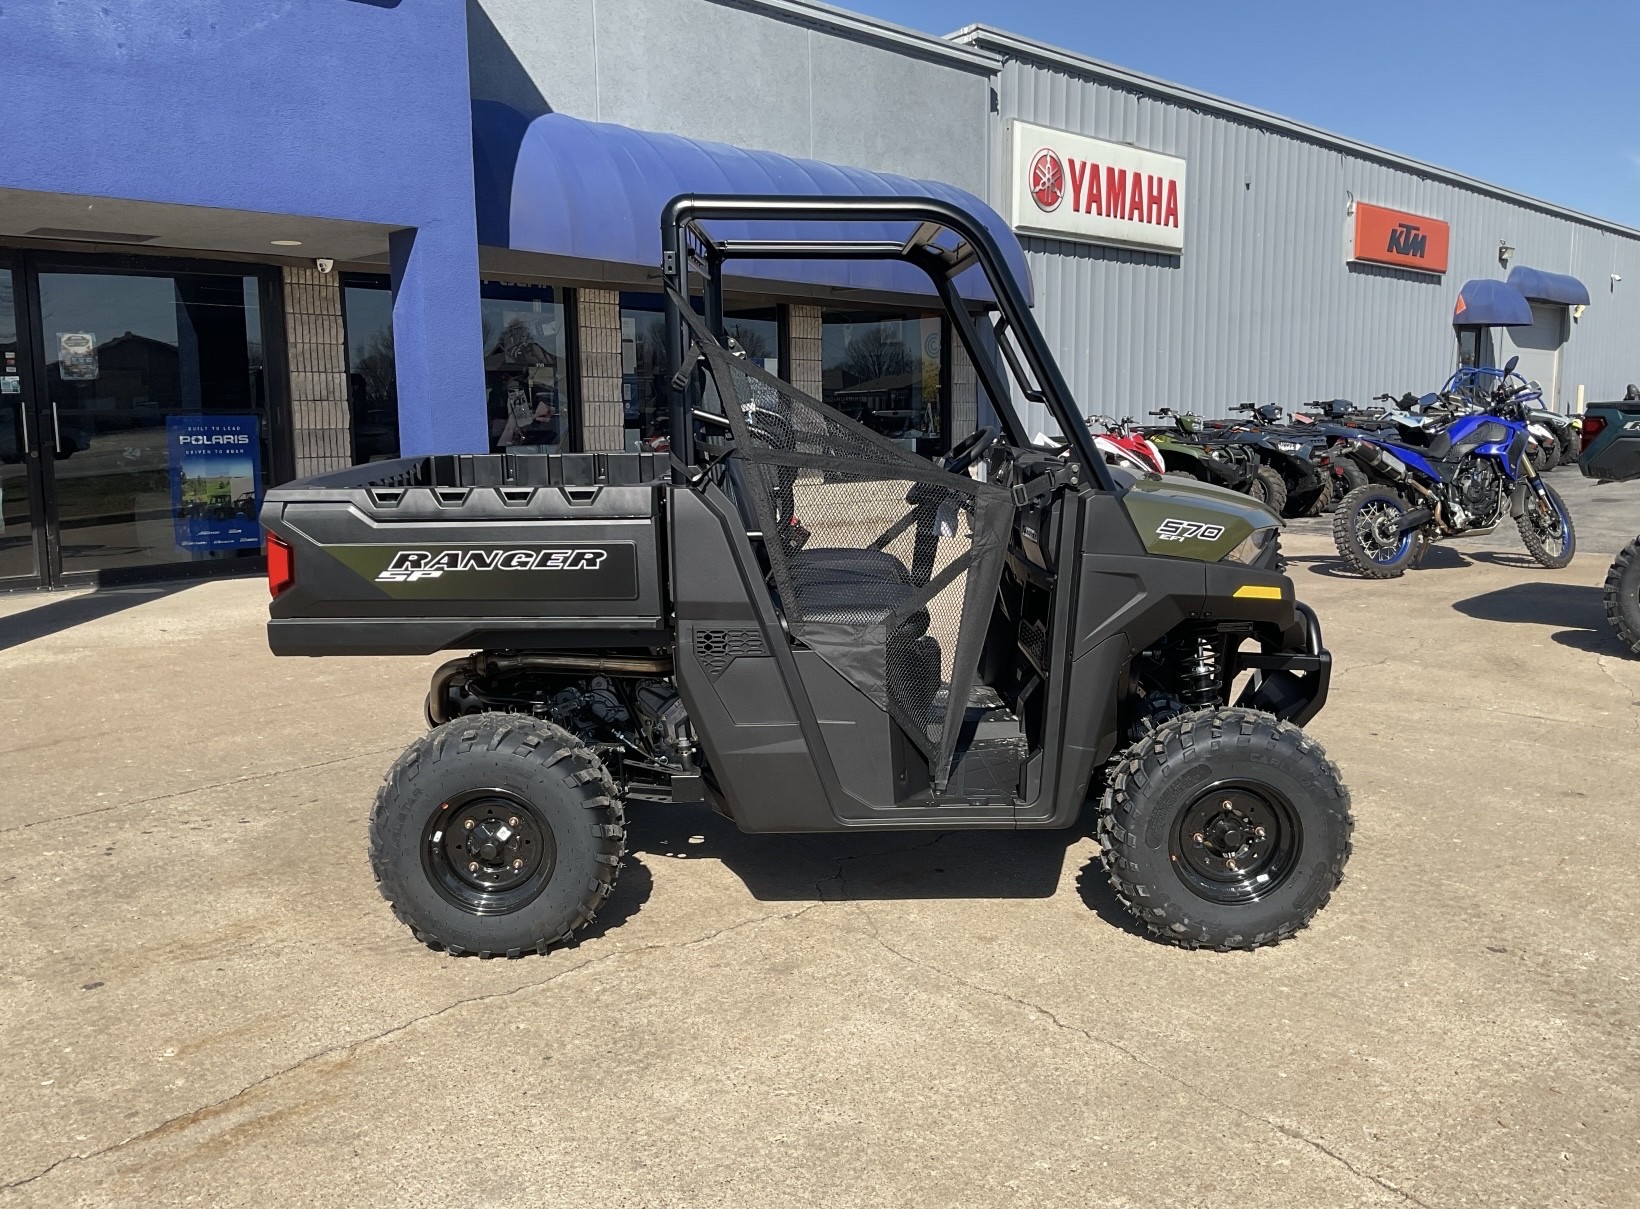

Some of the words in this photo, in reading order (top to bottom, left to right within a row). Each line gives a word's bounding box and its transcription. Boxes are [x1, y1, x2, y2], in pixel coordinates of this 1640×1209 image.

[1067, 158, 1179, 229] YAMAHA
[1387, 222, 1427, 258] KTM
[179, 434, 249, 445] POLARIS
[1156, 518, 1225, 541] 570
[1159, 533, 1185, 542] EFI
[388, 549, 608, 571] RANGER
[374, 570, 444, 582] SP
